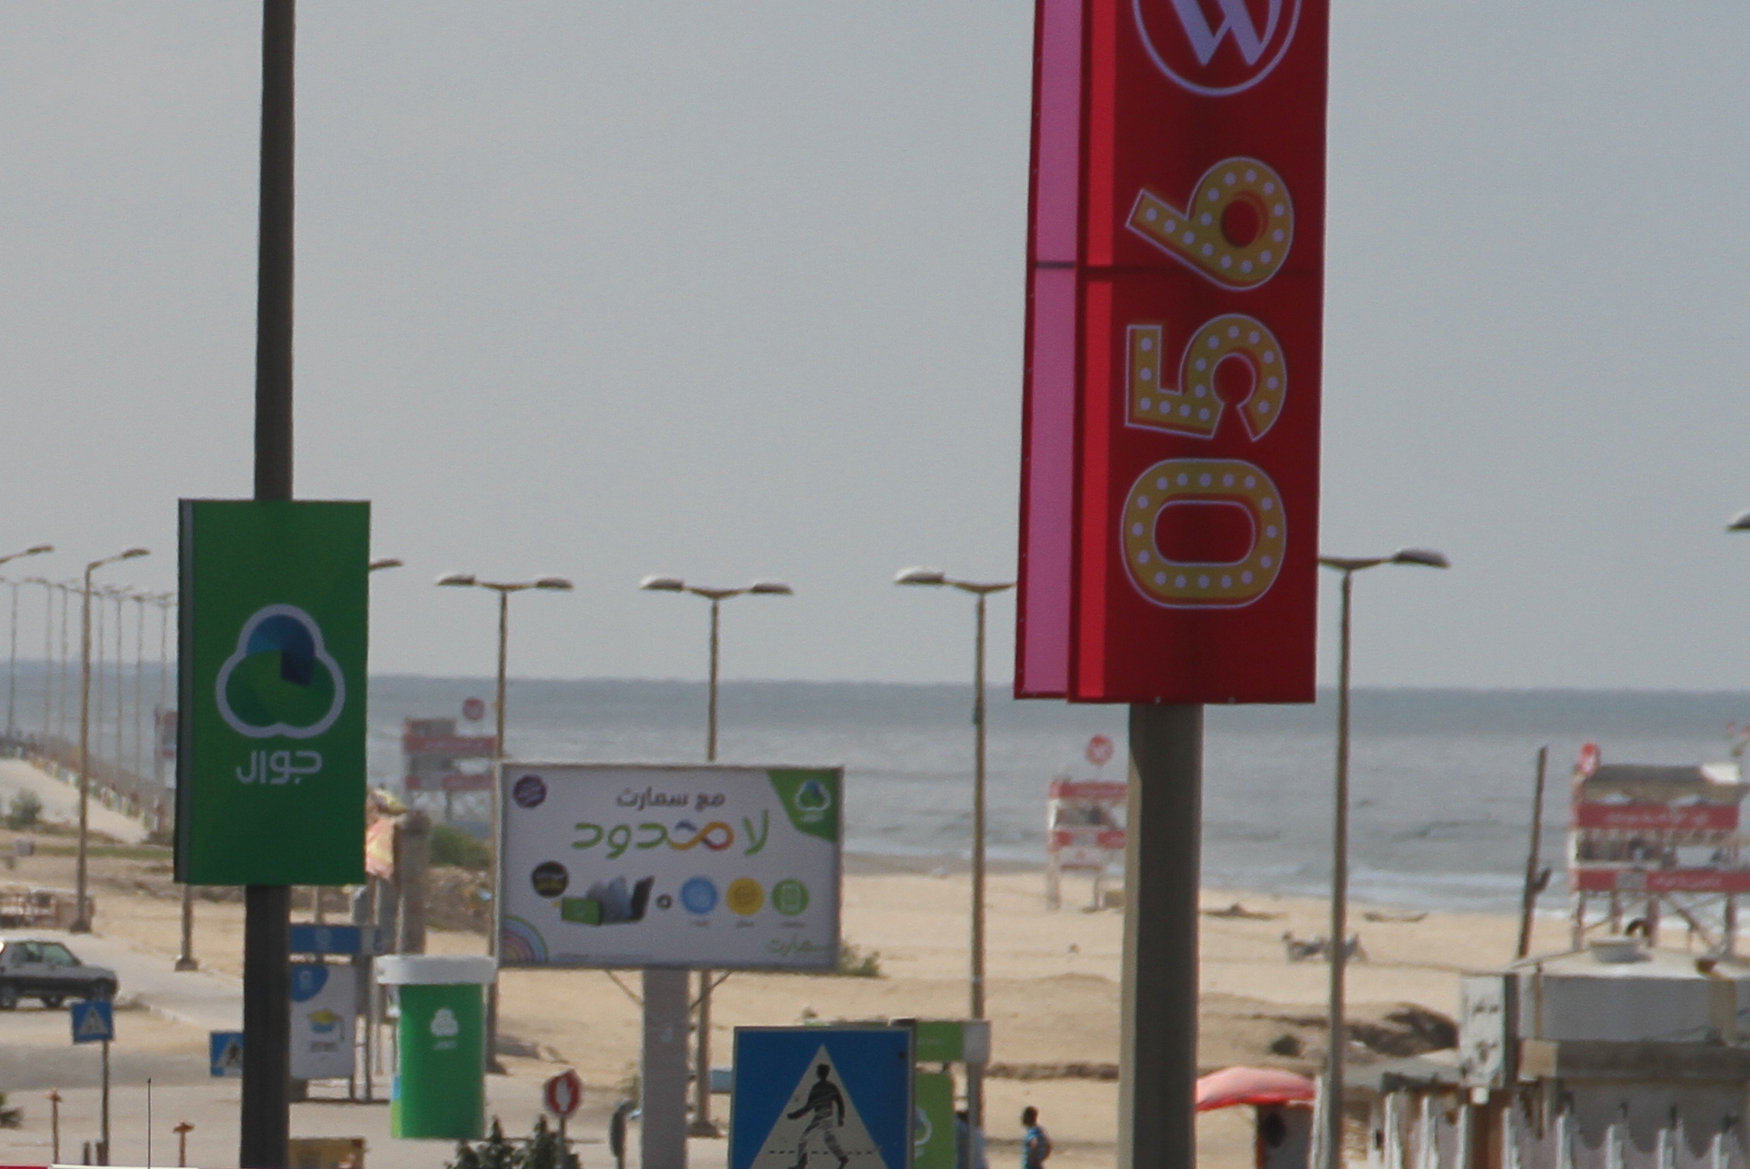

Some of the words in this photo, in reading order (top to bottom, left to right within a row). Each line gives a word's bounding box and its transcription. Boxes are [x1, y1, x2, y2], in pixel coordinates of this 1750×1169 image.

[1120, 156, 1295, 610] 056
[236, 750, 324, 785] جوال
[694, 791, 726, 813] مع
